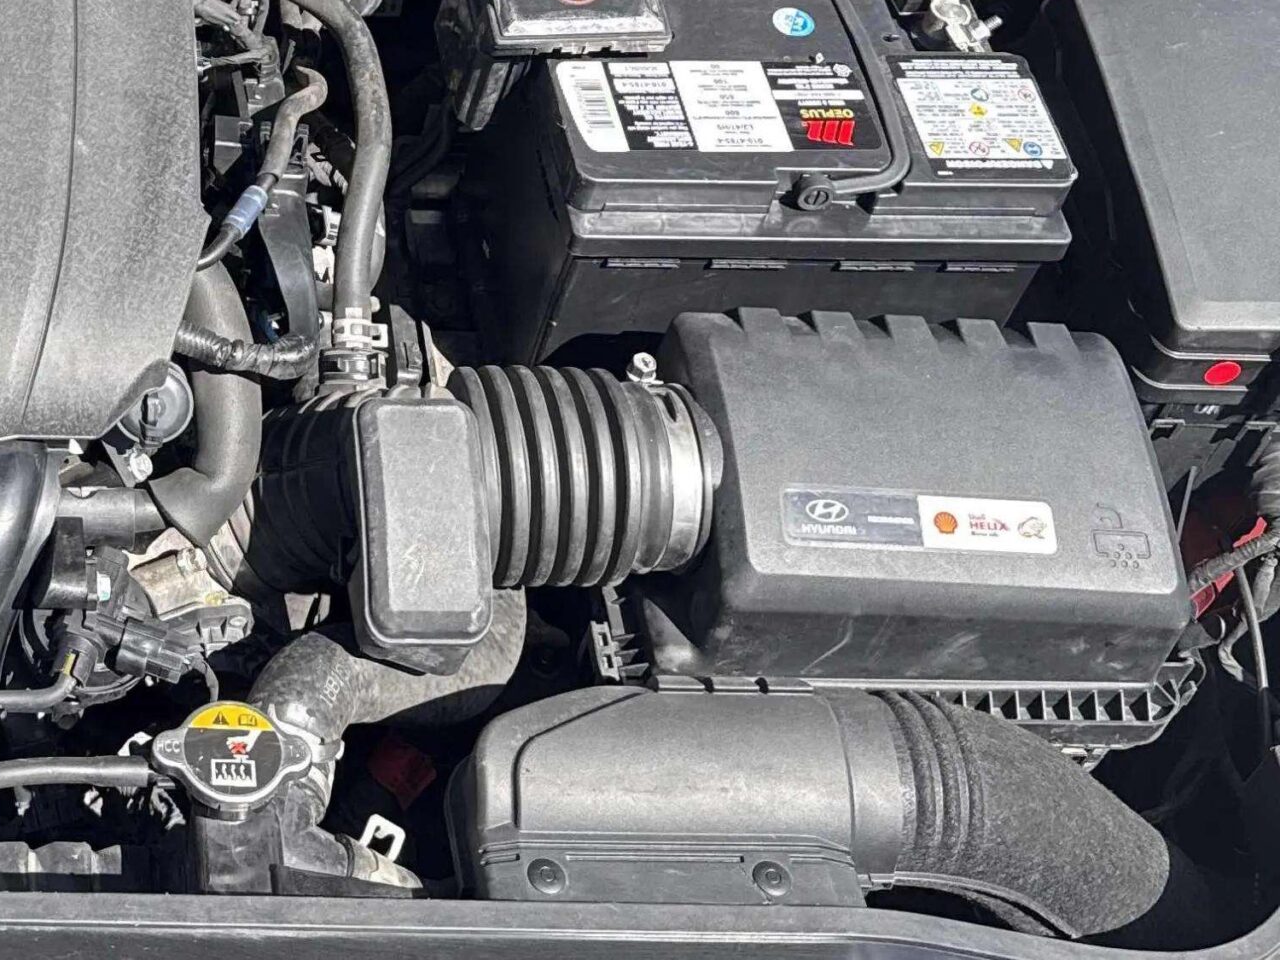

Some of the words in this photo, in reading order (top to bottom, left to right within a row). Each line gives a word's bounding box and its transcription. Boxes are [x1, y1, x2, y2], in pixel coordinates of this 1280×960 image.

[800, 108, 854, 119] OEPLUS
[801, 523, 858, 535] HYUNDAI
[969, 520, 1010, 532] HELIX
[156, 740, 181, 753] HCC
